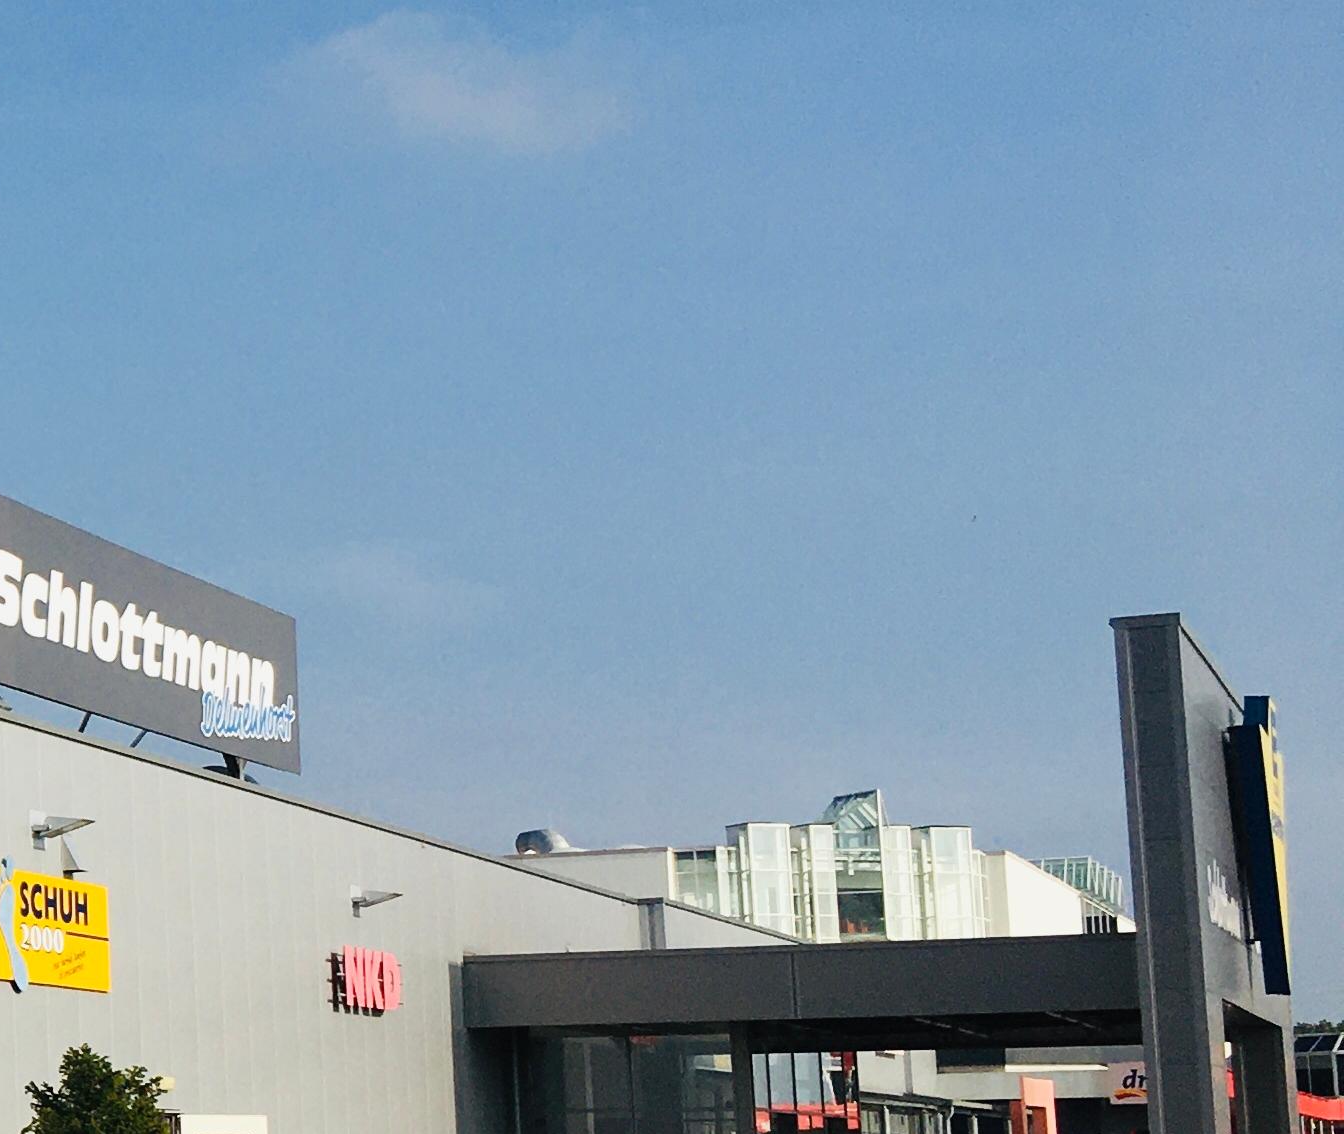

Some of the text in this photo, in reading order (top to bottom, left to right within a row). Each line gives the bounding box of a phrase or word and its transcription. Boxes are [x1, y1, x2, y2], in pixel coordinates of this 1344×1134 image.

[20, 881, 88, 926] SCHUH
[20, 923, 64, 955] 2000
[343, 944, 400, 1011] NKD
